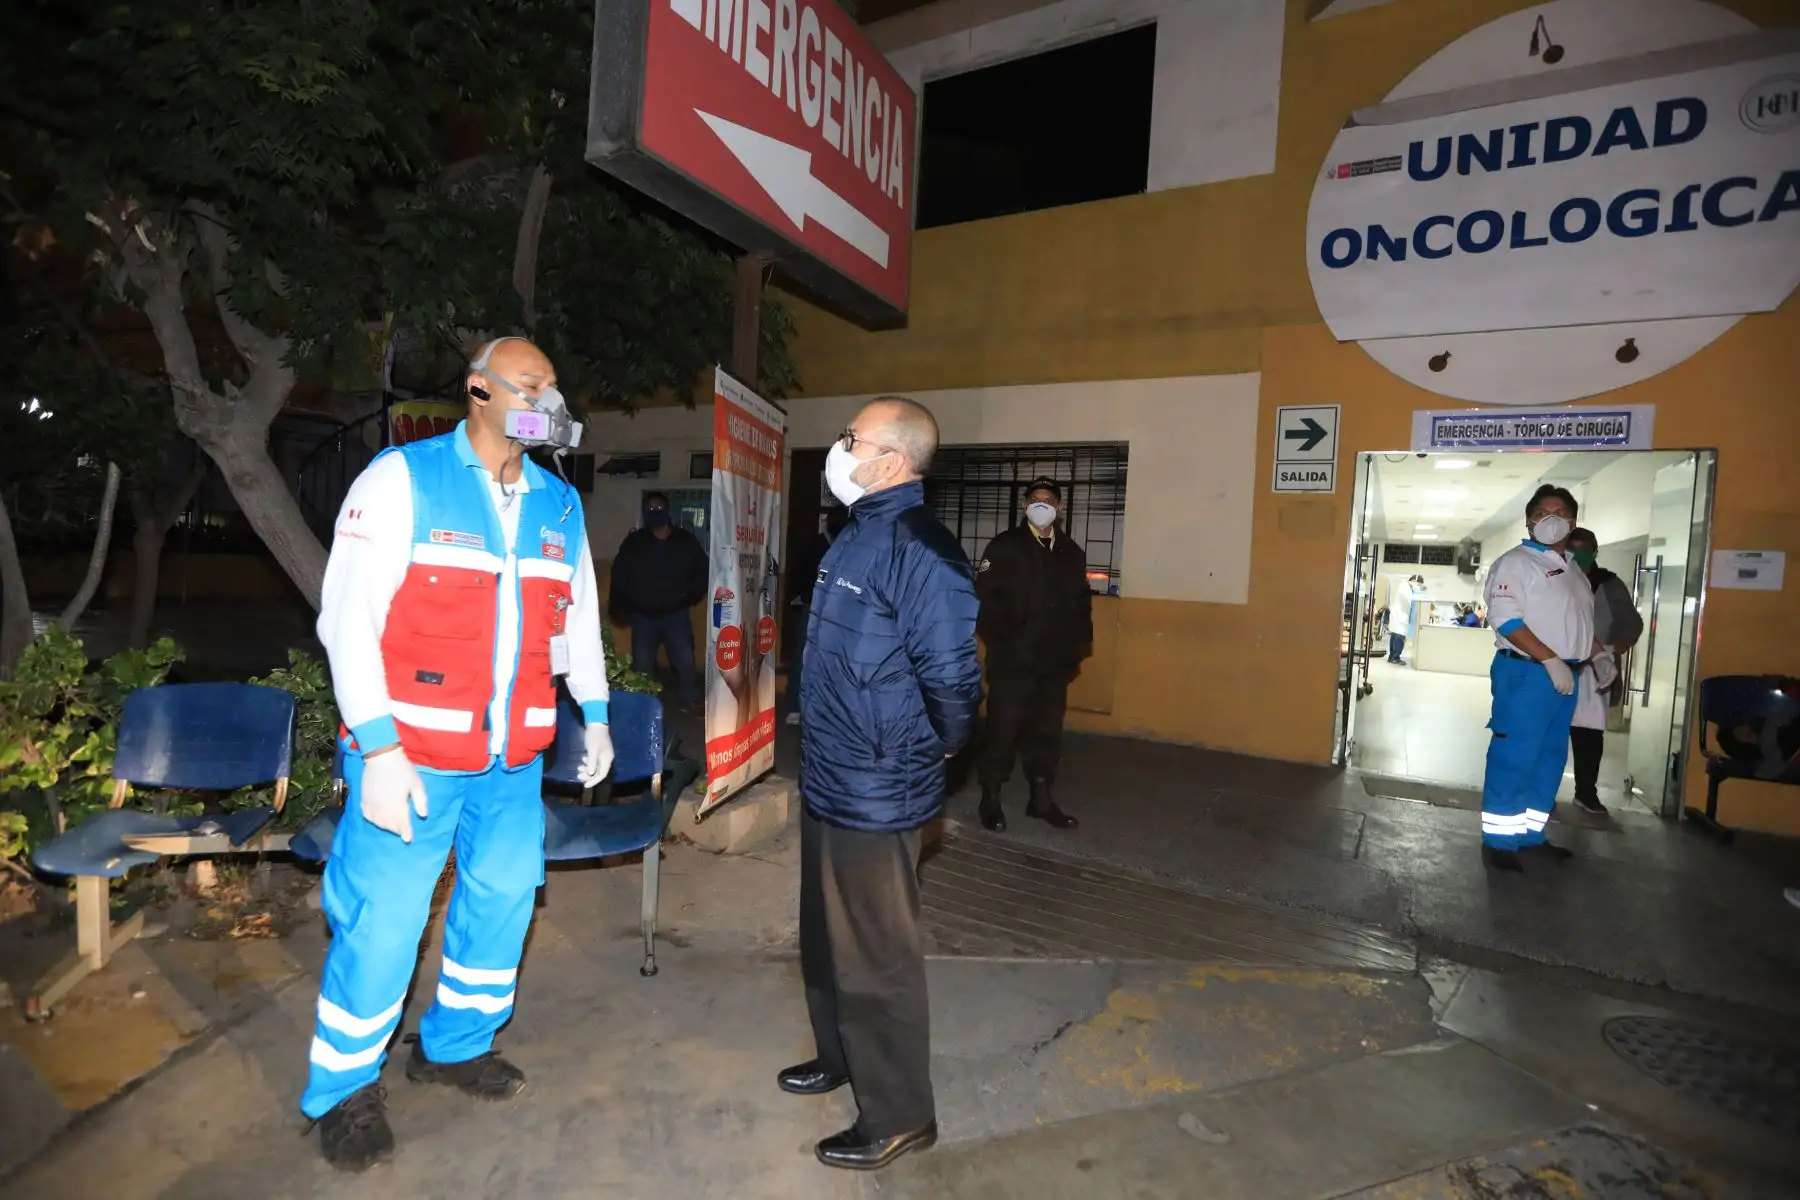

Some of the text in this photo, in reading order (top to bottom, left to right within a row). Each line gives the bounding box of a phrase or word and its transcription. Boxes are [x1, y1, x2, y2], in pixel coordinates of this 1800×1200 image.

[1407, 96, 1708, 182] UNIDAD
[1320, 169, 1800, 269] ONCOLOGICA
[1437, 424, 1504, 438] EMERGENCIA
[1514, 420, 1554, 437] TÓPICO
[1557, 422, 1573, 437] DE
[1576, 419, 1624, 437] CIRUGÍA
[1280, 471, 1328, 482] SALIDA
[723, 650, 734, 660] Gel
